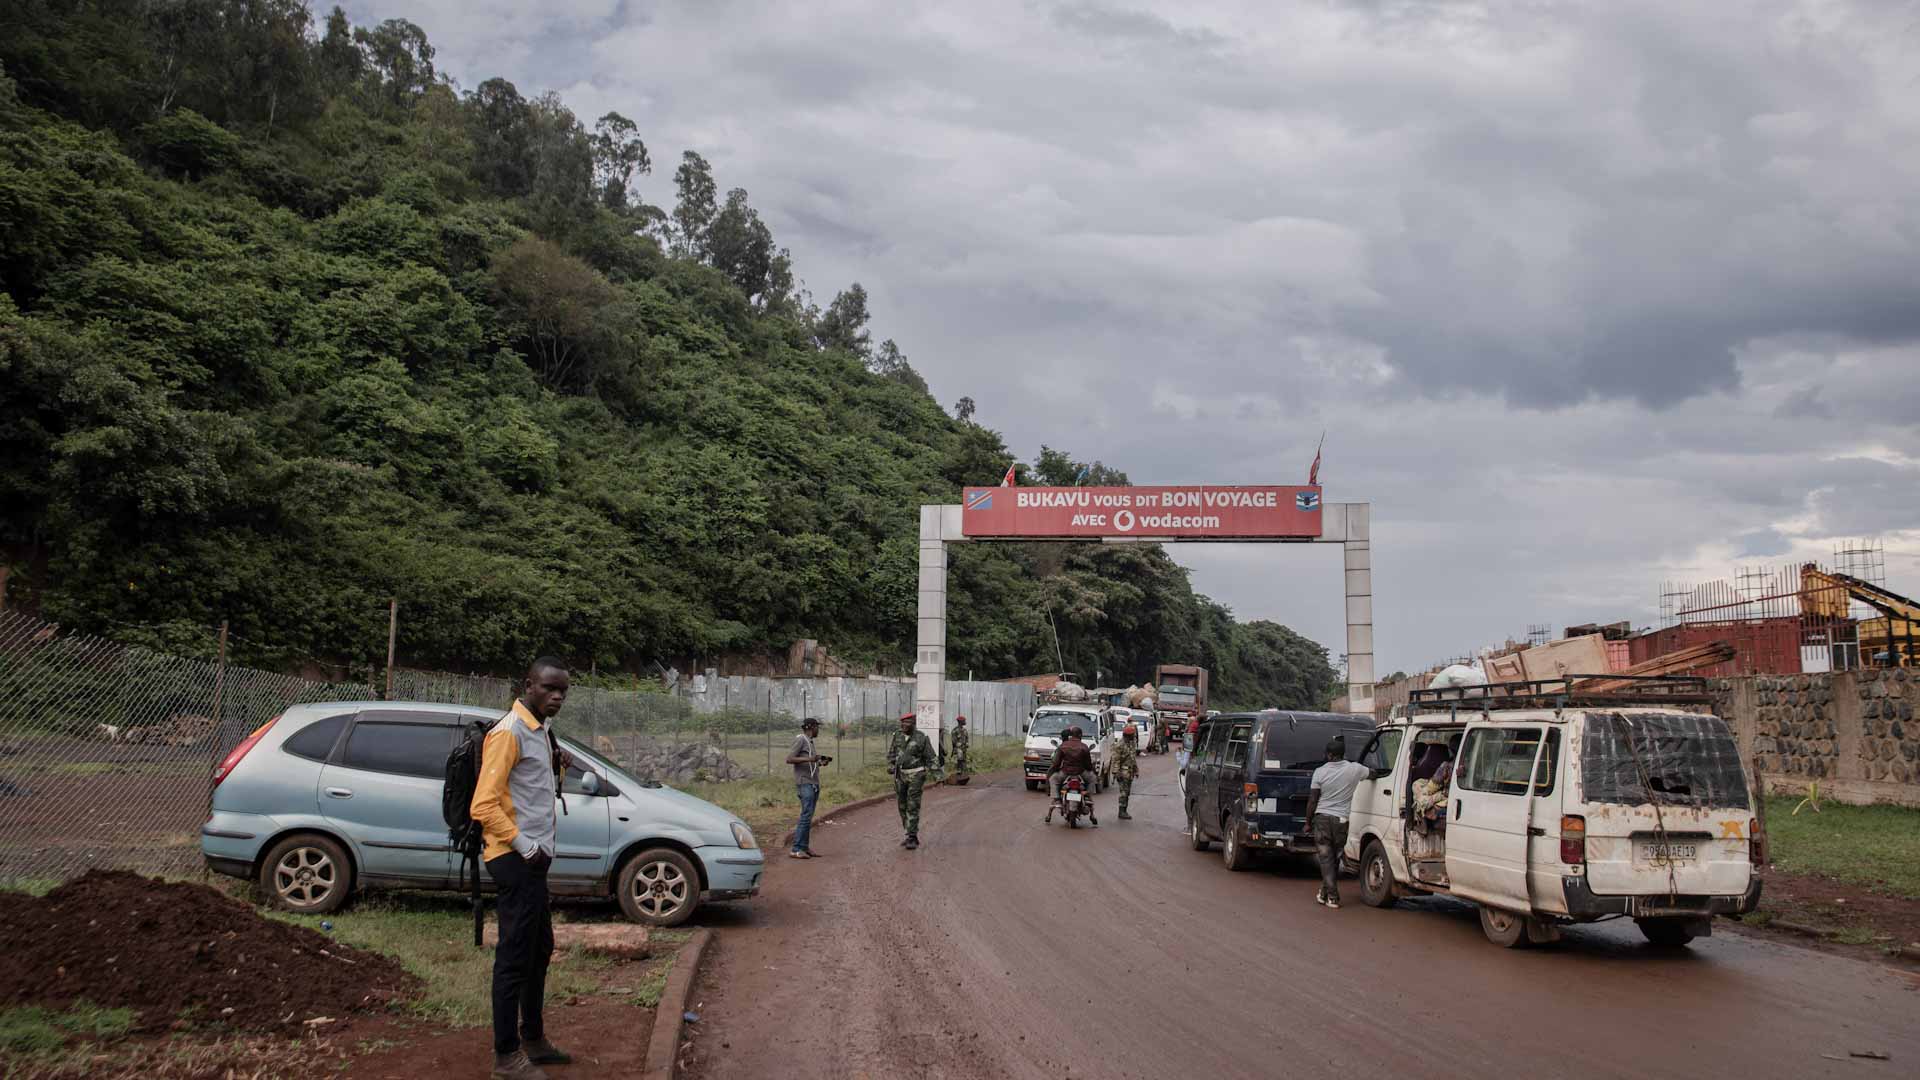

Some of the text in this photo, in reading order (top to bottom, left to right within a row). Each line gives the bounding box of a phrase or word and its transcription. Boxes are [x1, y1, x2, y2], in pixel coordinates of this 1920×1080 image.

[1017, 492, 1277, 507] BUKAVU VOUS DIT BON VOYAGE
[1071, 513, 1220, 528] AVEC vodacom
